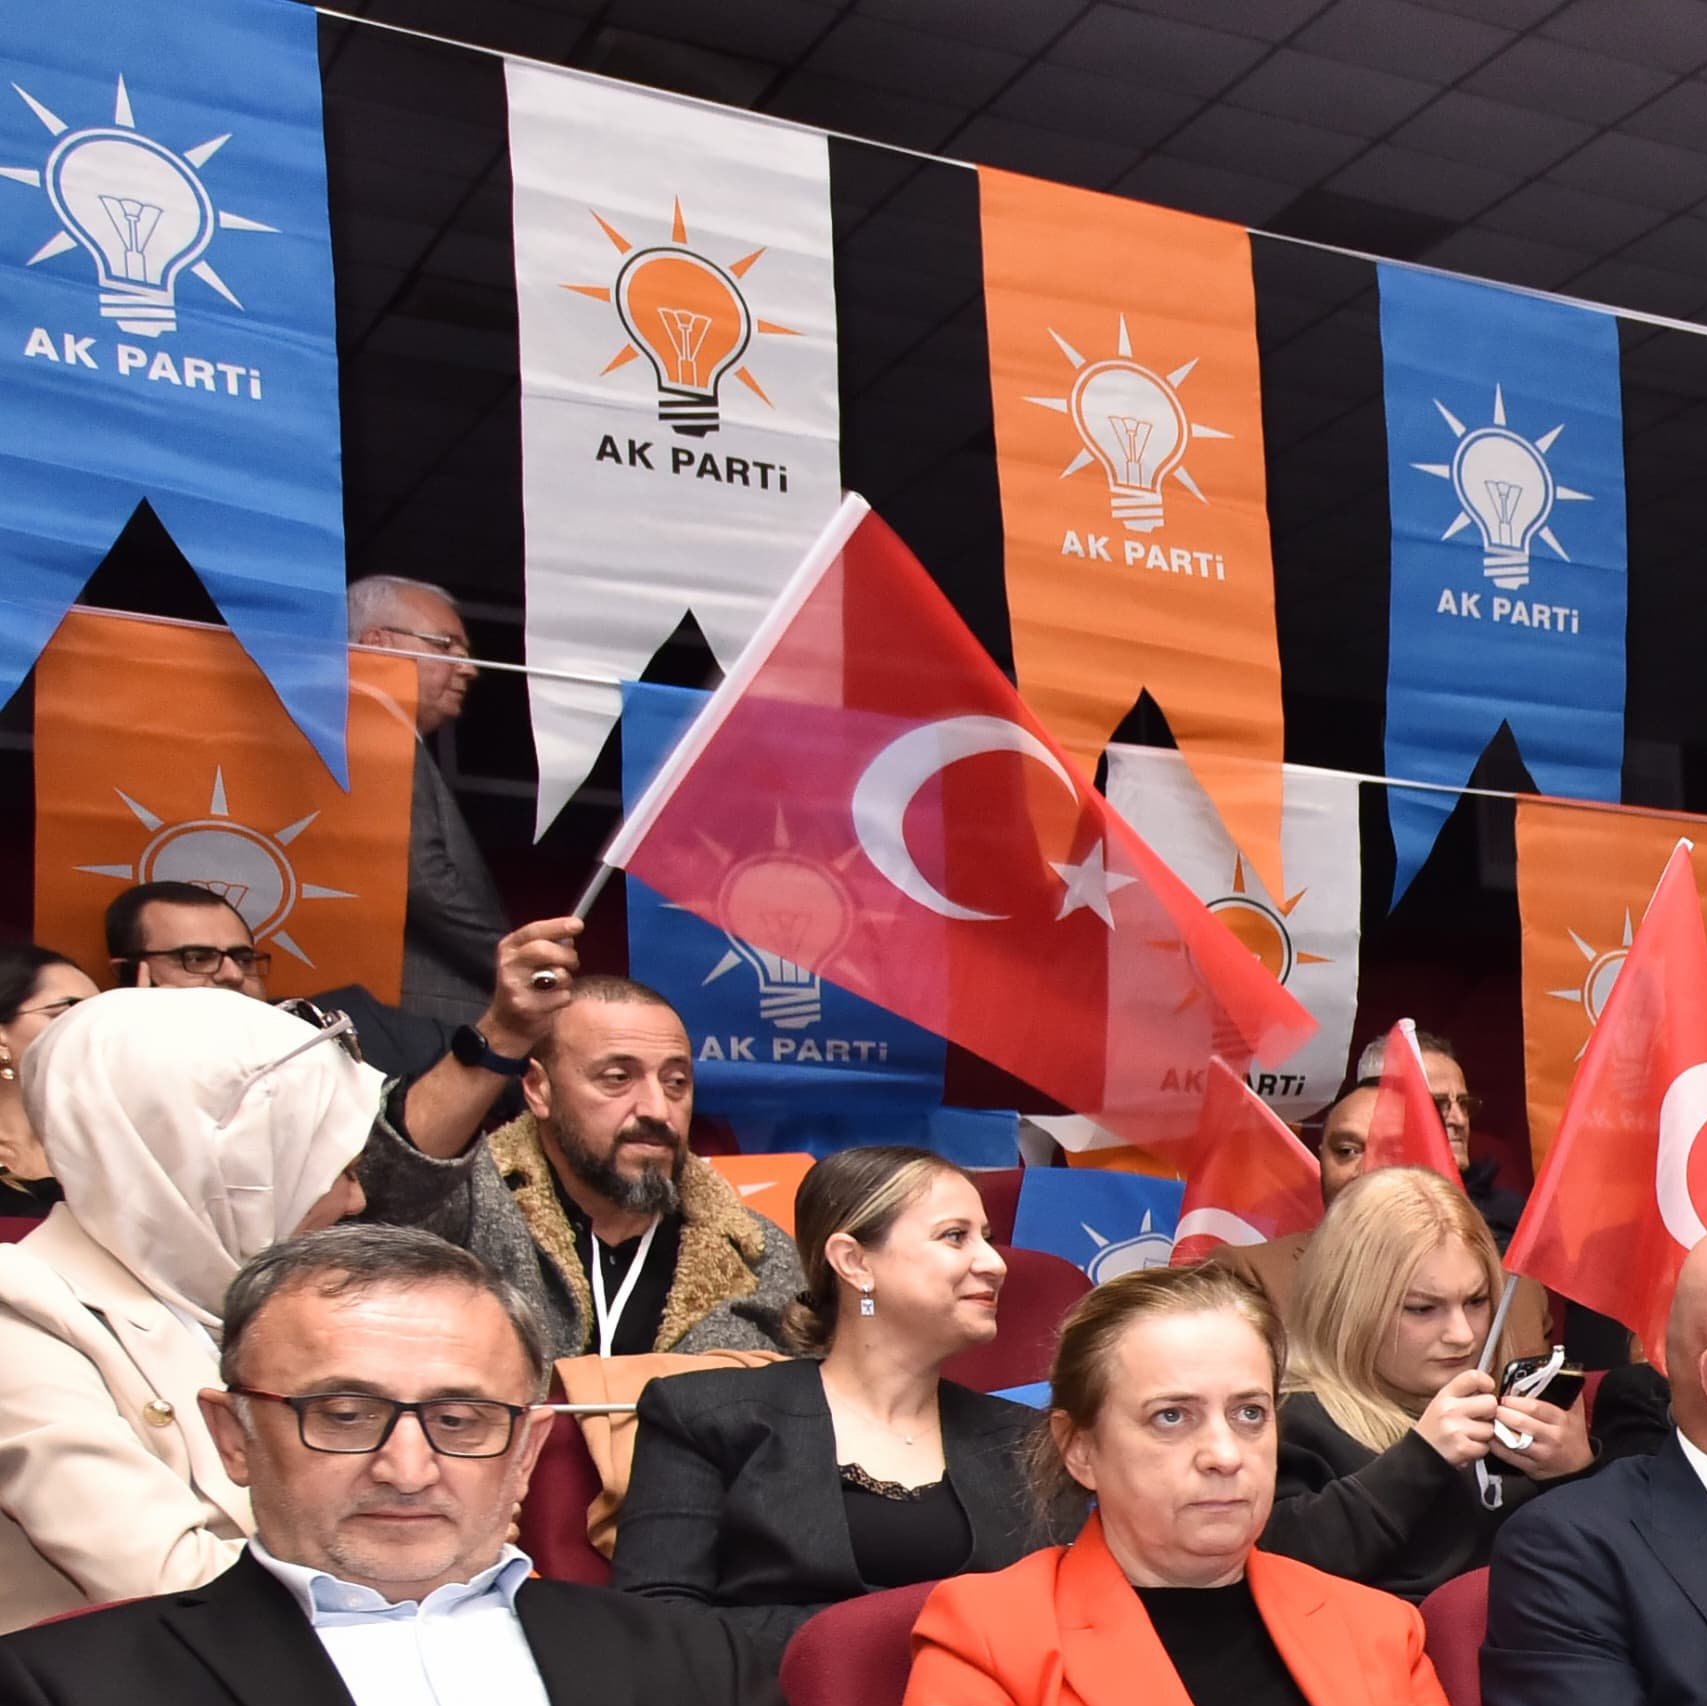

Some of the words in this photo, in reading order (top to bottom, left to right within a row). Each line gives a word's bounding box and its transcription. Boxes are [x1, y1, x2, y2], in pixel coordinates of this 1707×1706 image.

[24, 327, 99, 370] AK
[596, 434, 655, 471] AK
[1061, 530, 1112, 562] AK
[1437, 588, 1482, 620] AK
[698, 1035, 756, 1062] AK
[1159, 1067, 1205, 1093] AK
